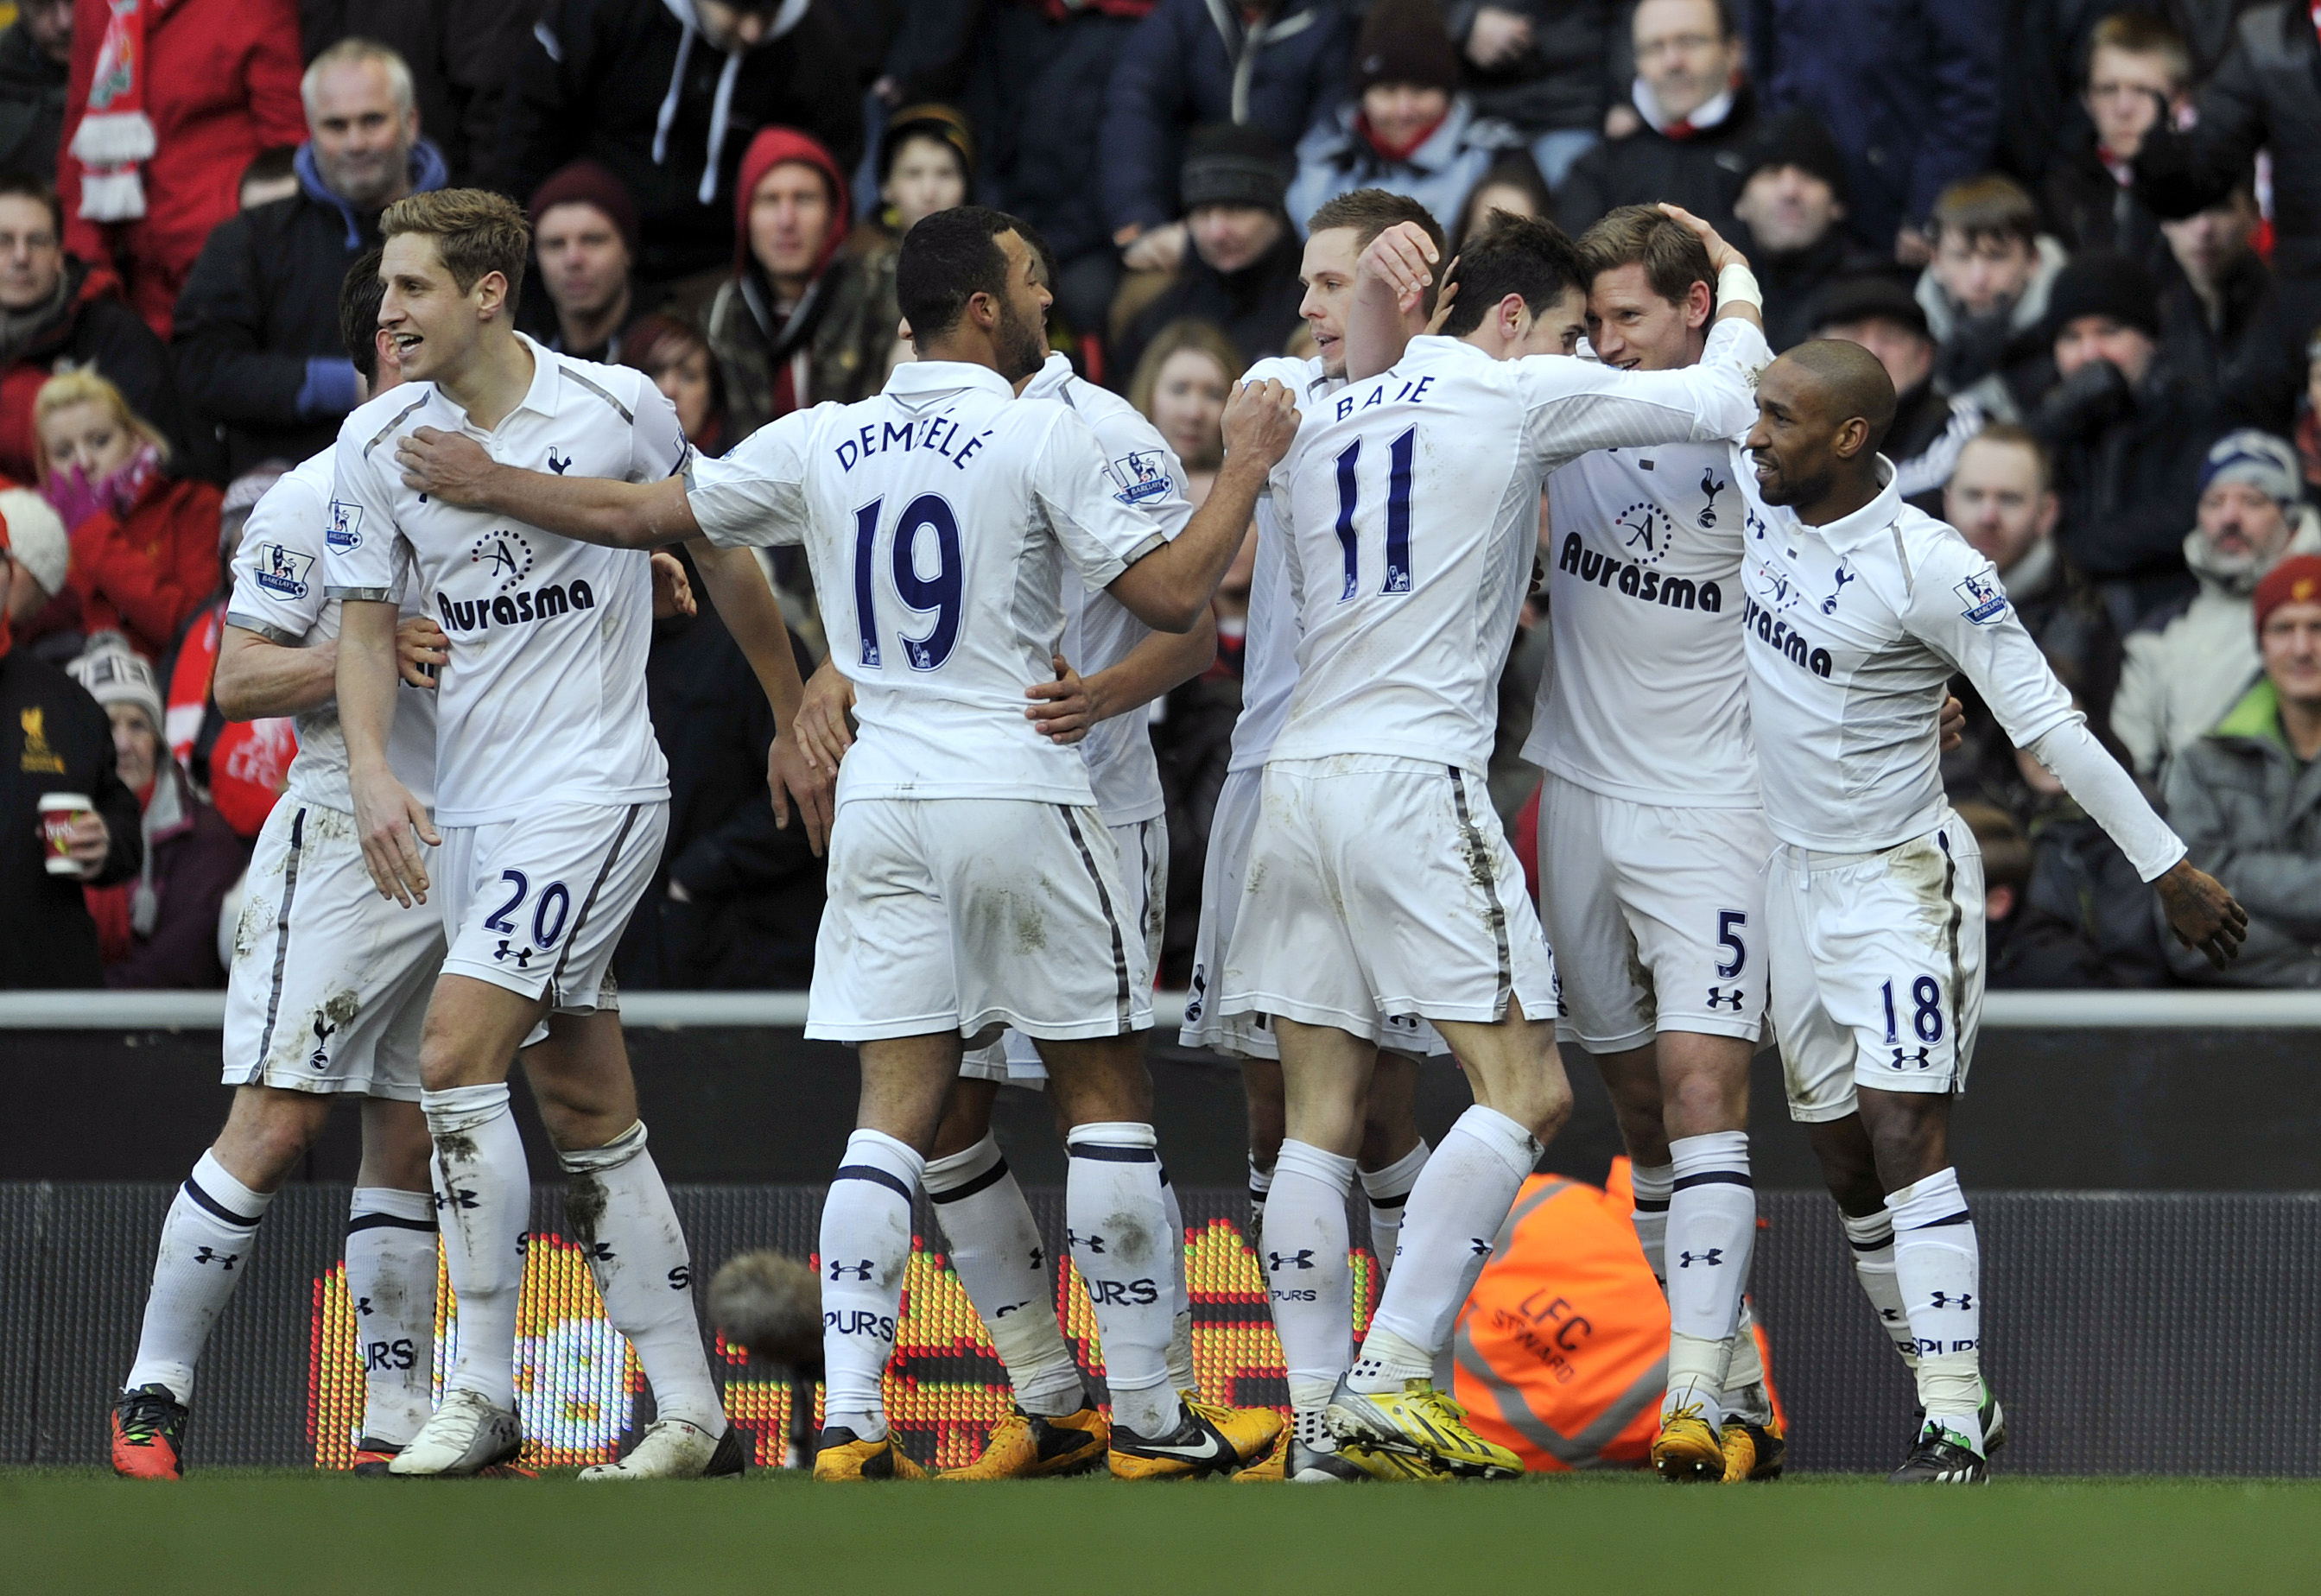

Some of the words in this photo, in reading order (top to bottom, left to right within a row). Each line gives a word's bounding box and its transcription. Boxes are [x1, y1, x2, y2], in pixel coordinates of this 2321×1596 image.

[1333, 422, 1417, 605] 11
[436, 580, 595, 631] Aurasma
[851, 491, 966, 673] 19
[1559, 531, 1722, 613] Aurasma
[482, 868, 570, 951] 20
[1715, 909, 1747, 979] 5
[1880, 975, 1944, 1045] 18
[823, 1309, 894, 1343] PURS
[1271, 1289, 1317, 1302] PURS
[1519, 1286, 1592, 1351] LFC
